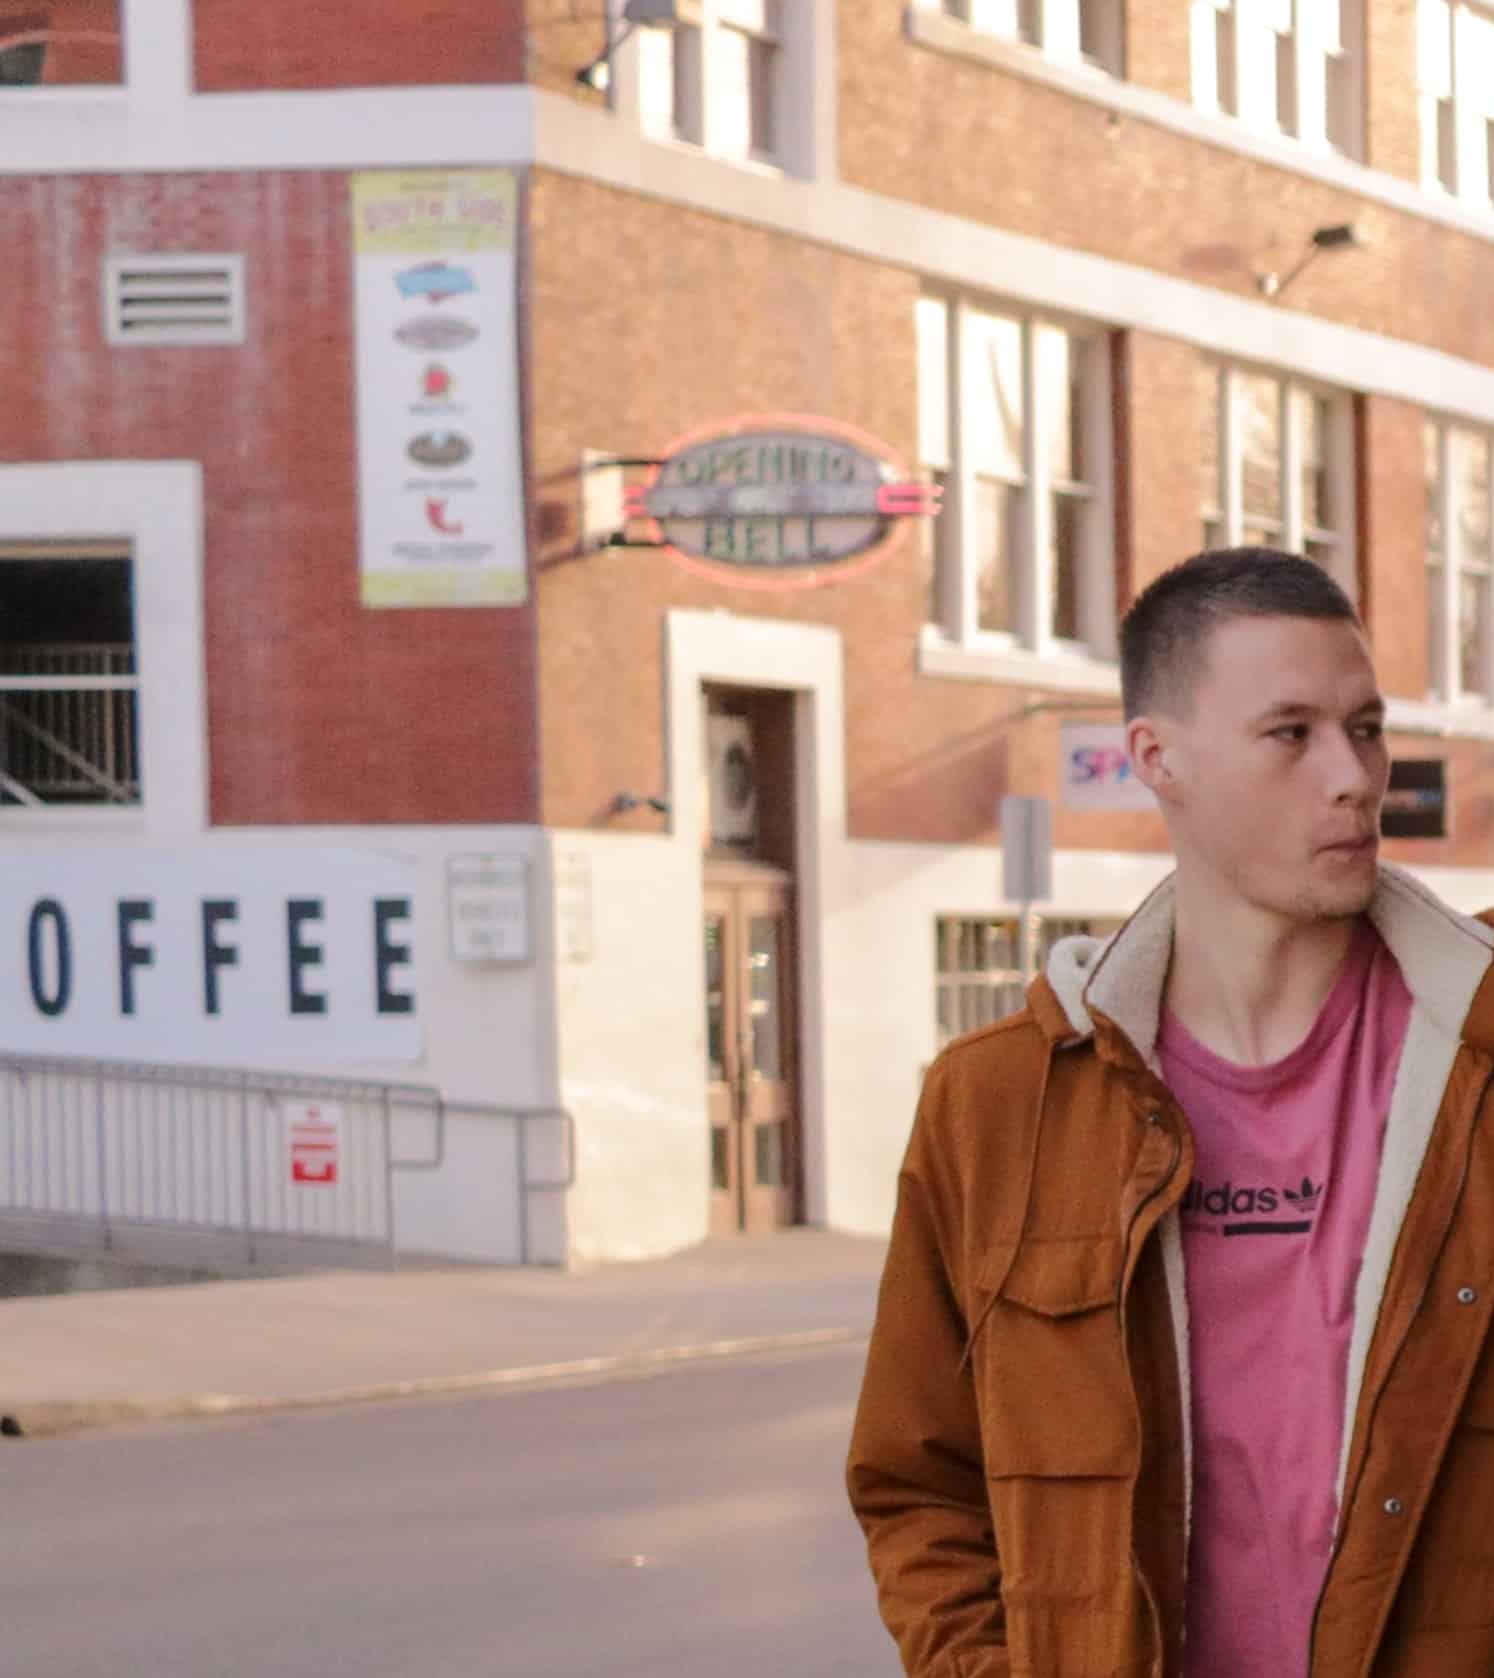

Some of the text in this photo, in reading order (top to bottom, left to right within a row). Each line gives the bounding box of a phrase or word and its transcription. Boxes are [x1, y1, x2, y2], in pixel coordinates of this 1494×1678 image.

[677, 446, 857, 486] OPENING
[704, 513, 834, 560] BELL
[27, 898, 415, 1017] OFFEE
